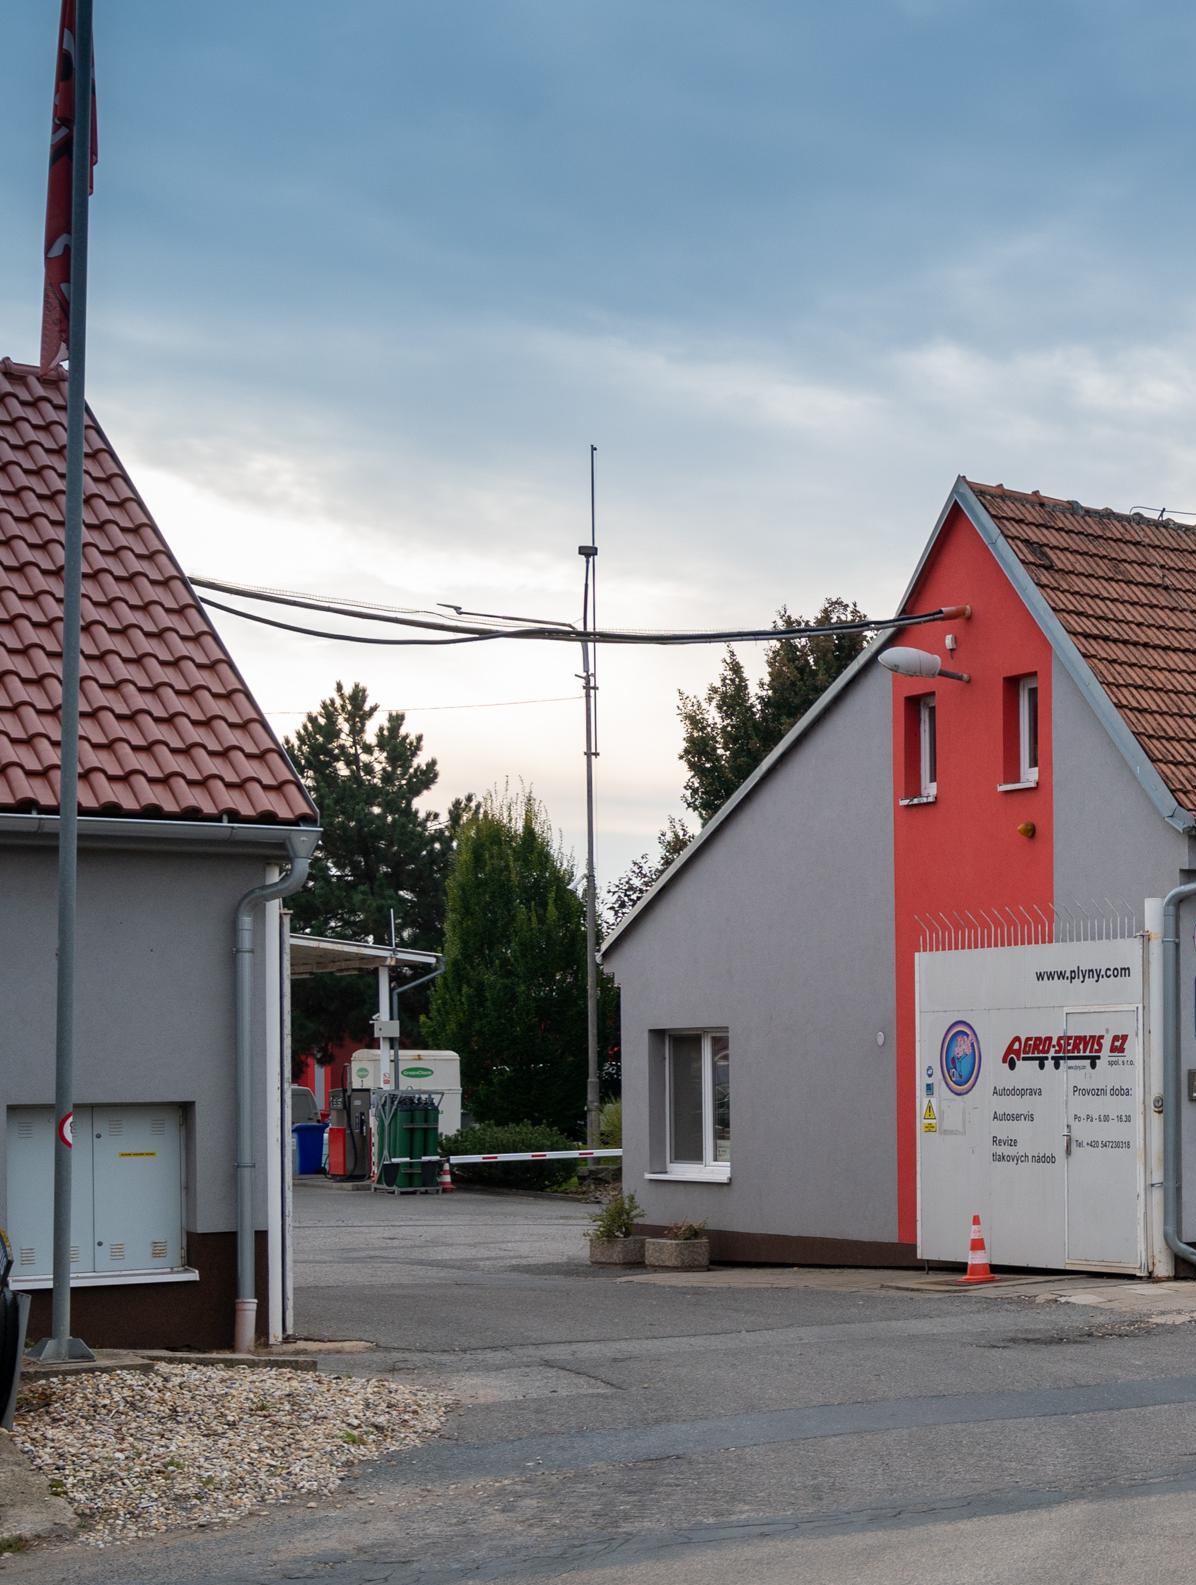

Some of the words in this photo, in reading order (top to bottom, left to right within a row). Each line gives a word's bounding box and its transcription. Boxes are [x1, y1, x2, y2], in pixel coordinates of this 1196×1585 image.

[1035, 965, 1131, 984] www.plyny.com
[1002, 1034, 1105, 1064] AGRO-SERVIS
[1109, 1034, 1129, 1054] CZ
[1107, 1058, 1121, 1067] spol.
[992, 1086, 1042, 1098] Autodoprava
[1072, 1086, 1108, 1097] Provozní
[1109, 1086, 1133, 1097] doba:
[992, 1111, 1035, 1122] Autoservis
[1073, 1114, 1082, 1122] Po
[992, 1136, 1018, 1147] Revize
[1075, 1139, 1085, 1148] Tel.
[1086, 1140, 1100, 1148] +420
[992, 1152, 1030, 1165] tlakových
[1031, 1152, 1057, 1164] nádob
